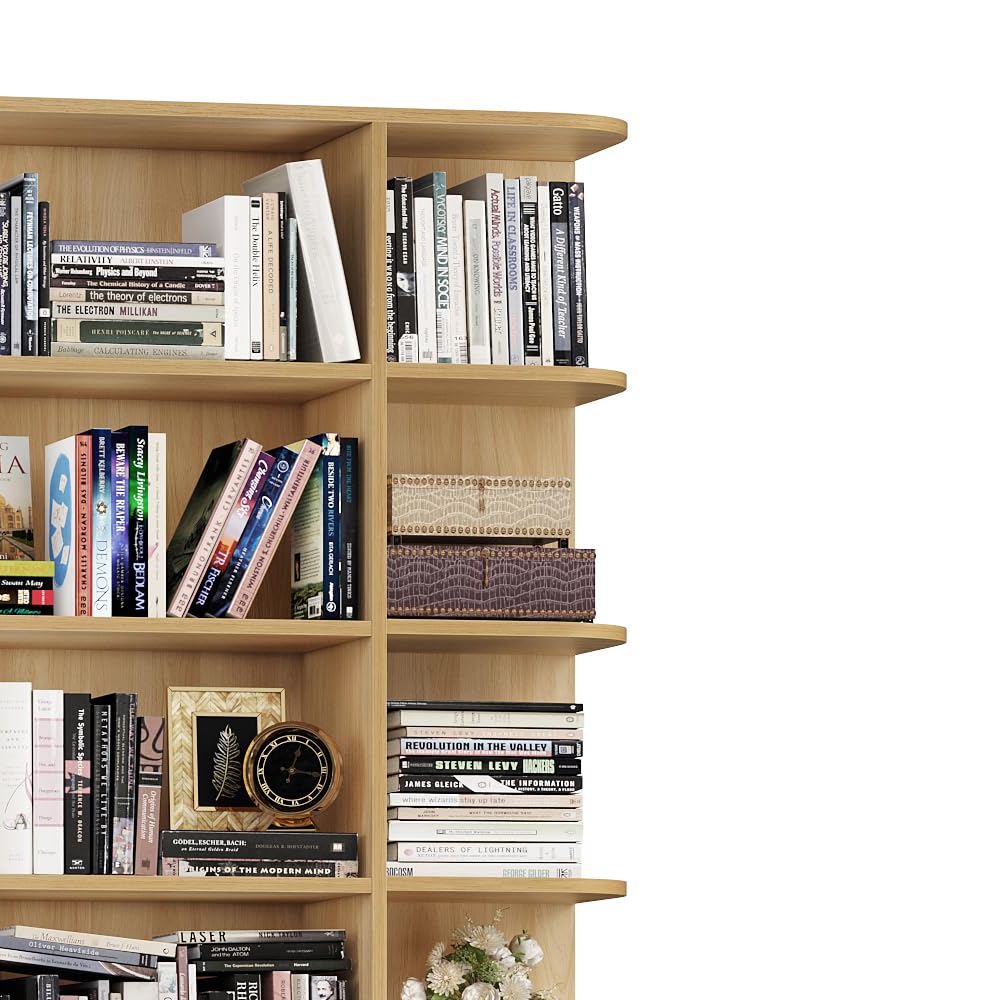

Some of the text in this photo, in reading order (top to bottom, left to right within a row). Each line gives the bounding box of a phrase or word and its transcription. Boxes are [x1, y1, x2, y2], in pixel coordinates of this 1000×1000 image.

[552, 188, 564, 215] Gatto
[252, 218, 260, 287] The Double Helix
[96, 267, 157, 278] Physics and Beyond
[90, 291, 187, 302] the theory of electrons
[556, 237, 566, 338] Different Kind of Teacher
[57, 305, 158, 316] THE ELECTRON MILLIKAN
[115, 443, 125, 532] BEWARE THE REAPER
[136, 471, 145, 522] Livingston
[96, 541, 110, 612] DEMONS
[133, 563, 145, 611] BEDLAM
[195, 568, 221, 606] FISCHER
[406, 742, 547, 751] REVOLUTION IN THE VALLEY
[436, 761, 518, 770] STEVEN LEVY
[102, 773, 107, 786] WE
[101, 822, 107, 834] BY
[181, 932, 226, 942] LASER
